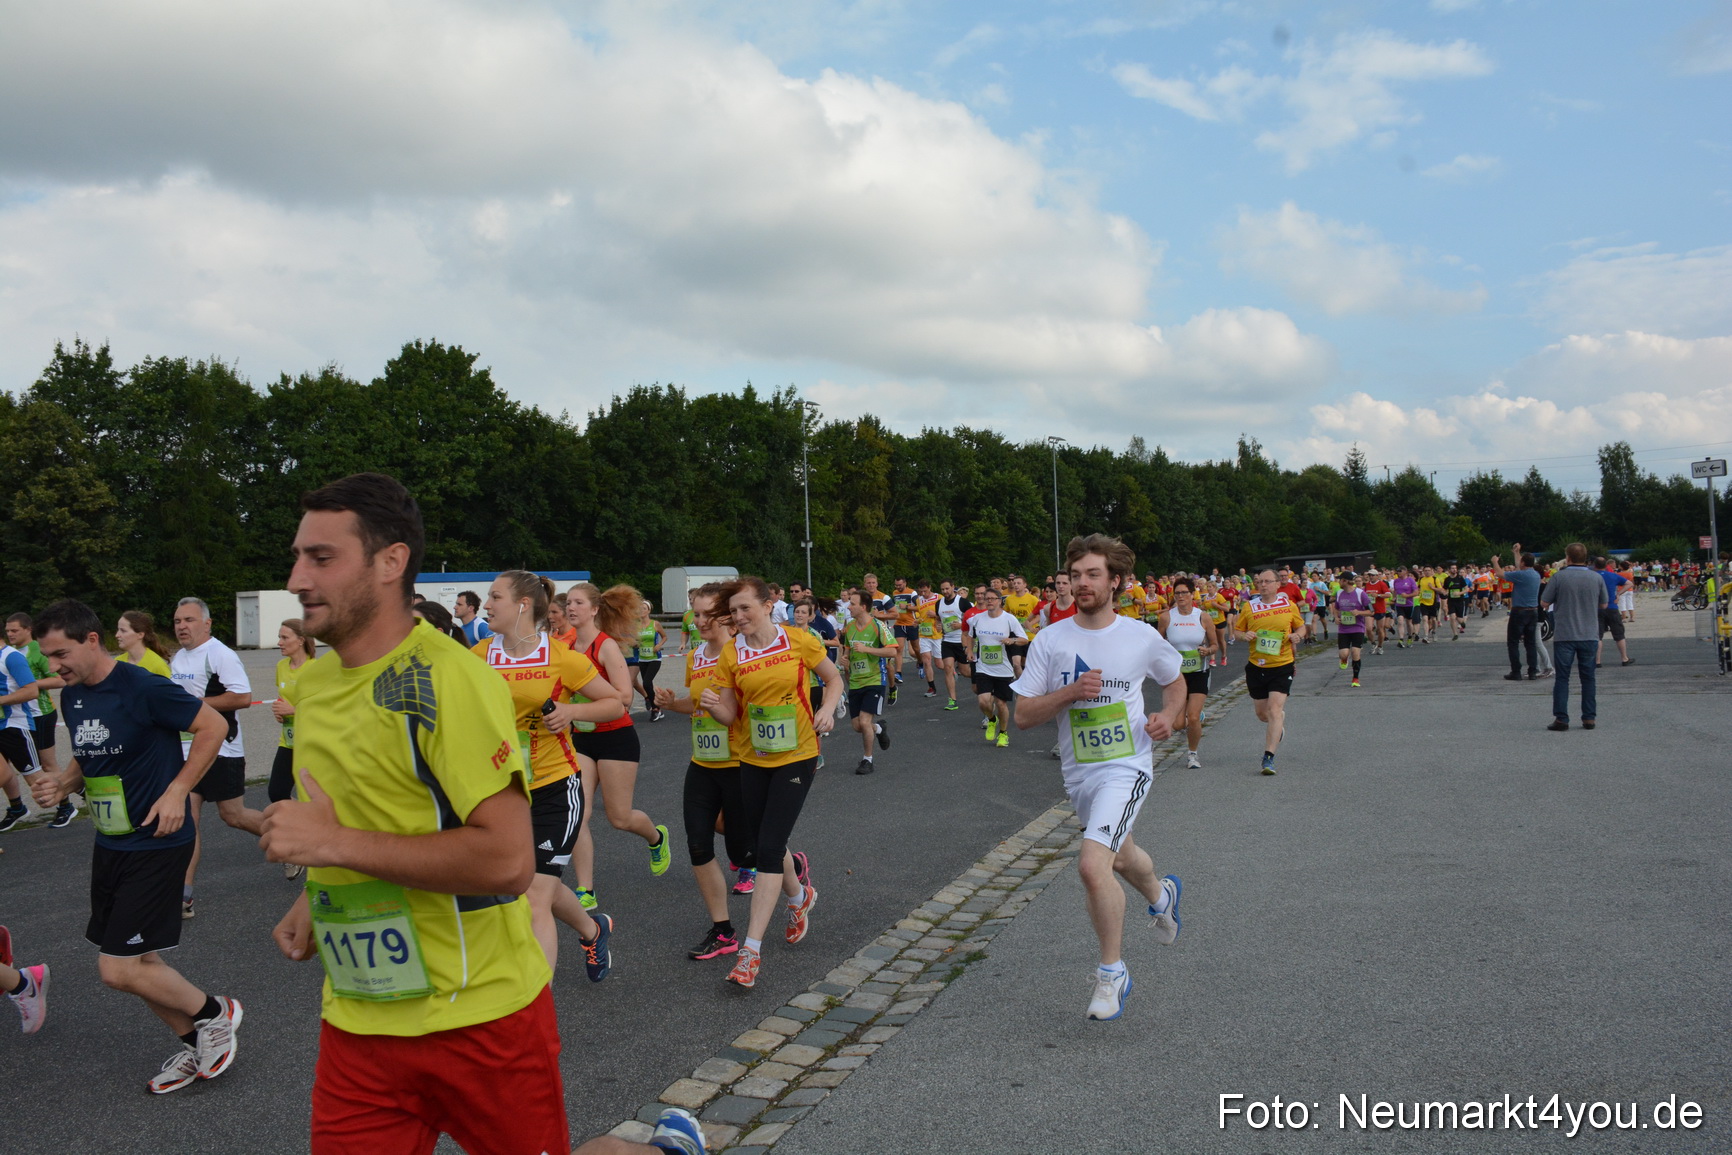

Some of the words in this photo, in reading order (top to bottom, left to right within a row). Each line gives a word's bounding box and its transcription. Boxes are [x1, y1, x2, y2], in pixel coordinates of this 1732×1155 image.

[1693, 465, 1707, 473] WC
[1253, 612, 1270, 620] MAX
[1261, 638, 1277, 648] 917
[985, 652, 998, 660] 280
[739, 662, 761, 676] MAX
[764, 653, 795, 668] BÖGL
[853, 661, 866, 670] 152
[514, 669, 551, 681] BÖGL
[757, 723, 785, 739] 901
[1077, 724, 1126, 748] 1585
[697, 734, 720, 749] 900
[323, 927, 409, 968] 1179
